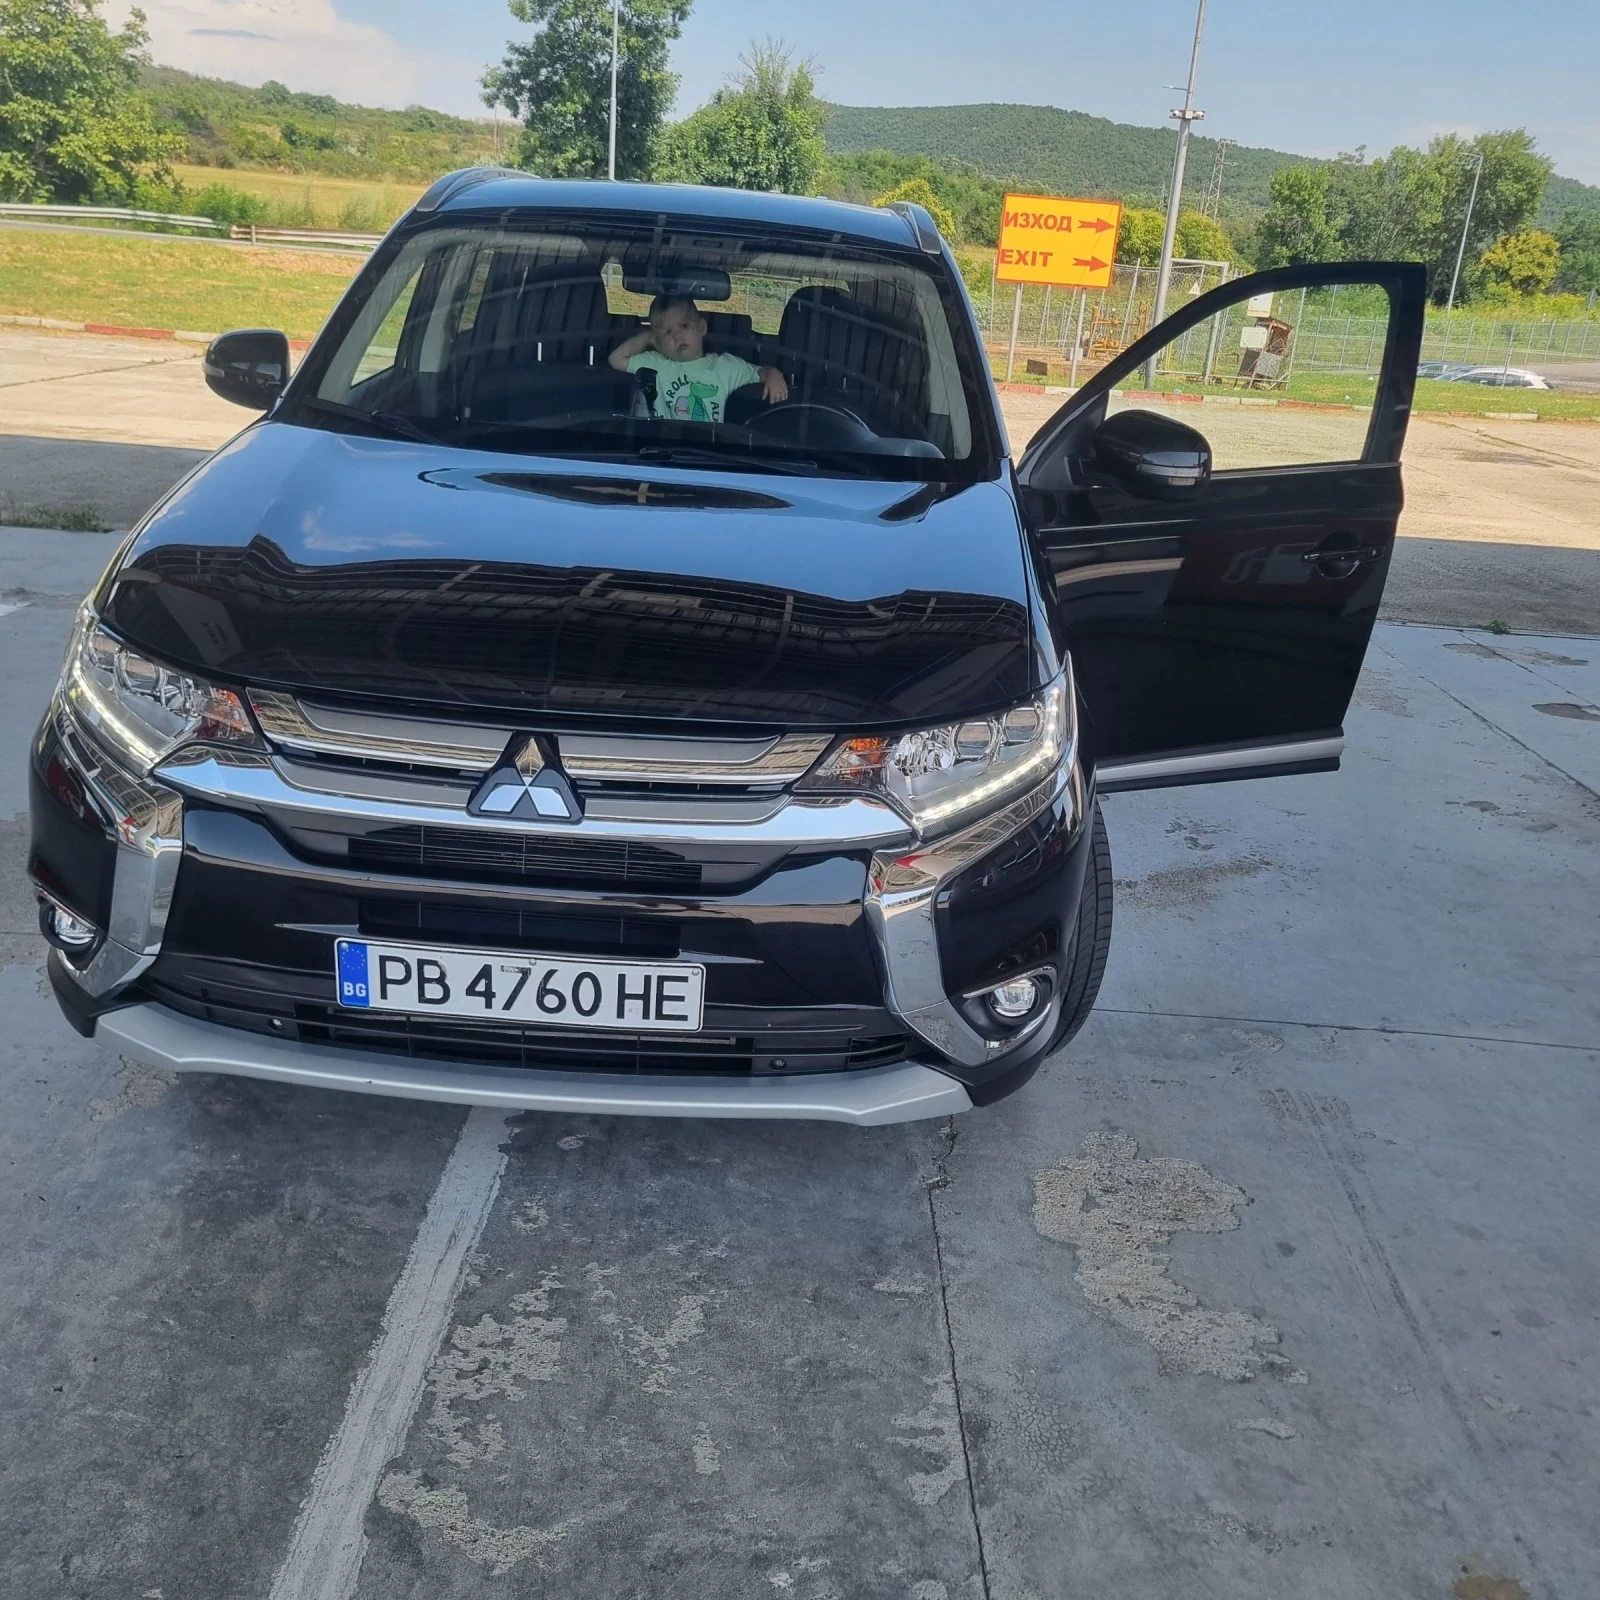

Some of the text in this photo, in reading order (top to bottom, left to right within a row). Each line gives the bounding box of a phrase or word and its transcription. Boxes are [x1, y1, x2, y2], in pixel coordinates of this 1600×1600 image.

[1004, 211, 1072, 233] ИЗХОД
[999, 249, 1053, 267] EXIT
[343, 981, 367, 997] BG
[378, 955, 689, 1022] PB 4760 HE
